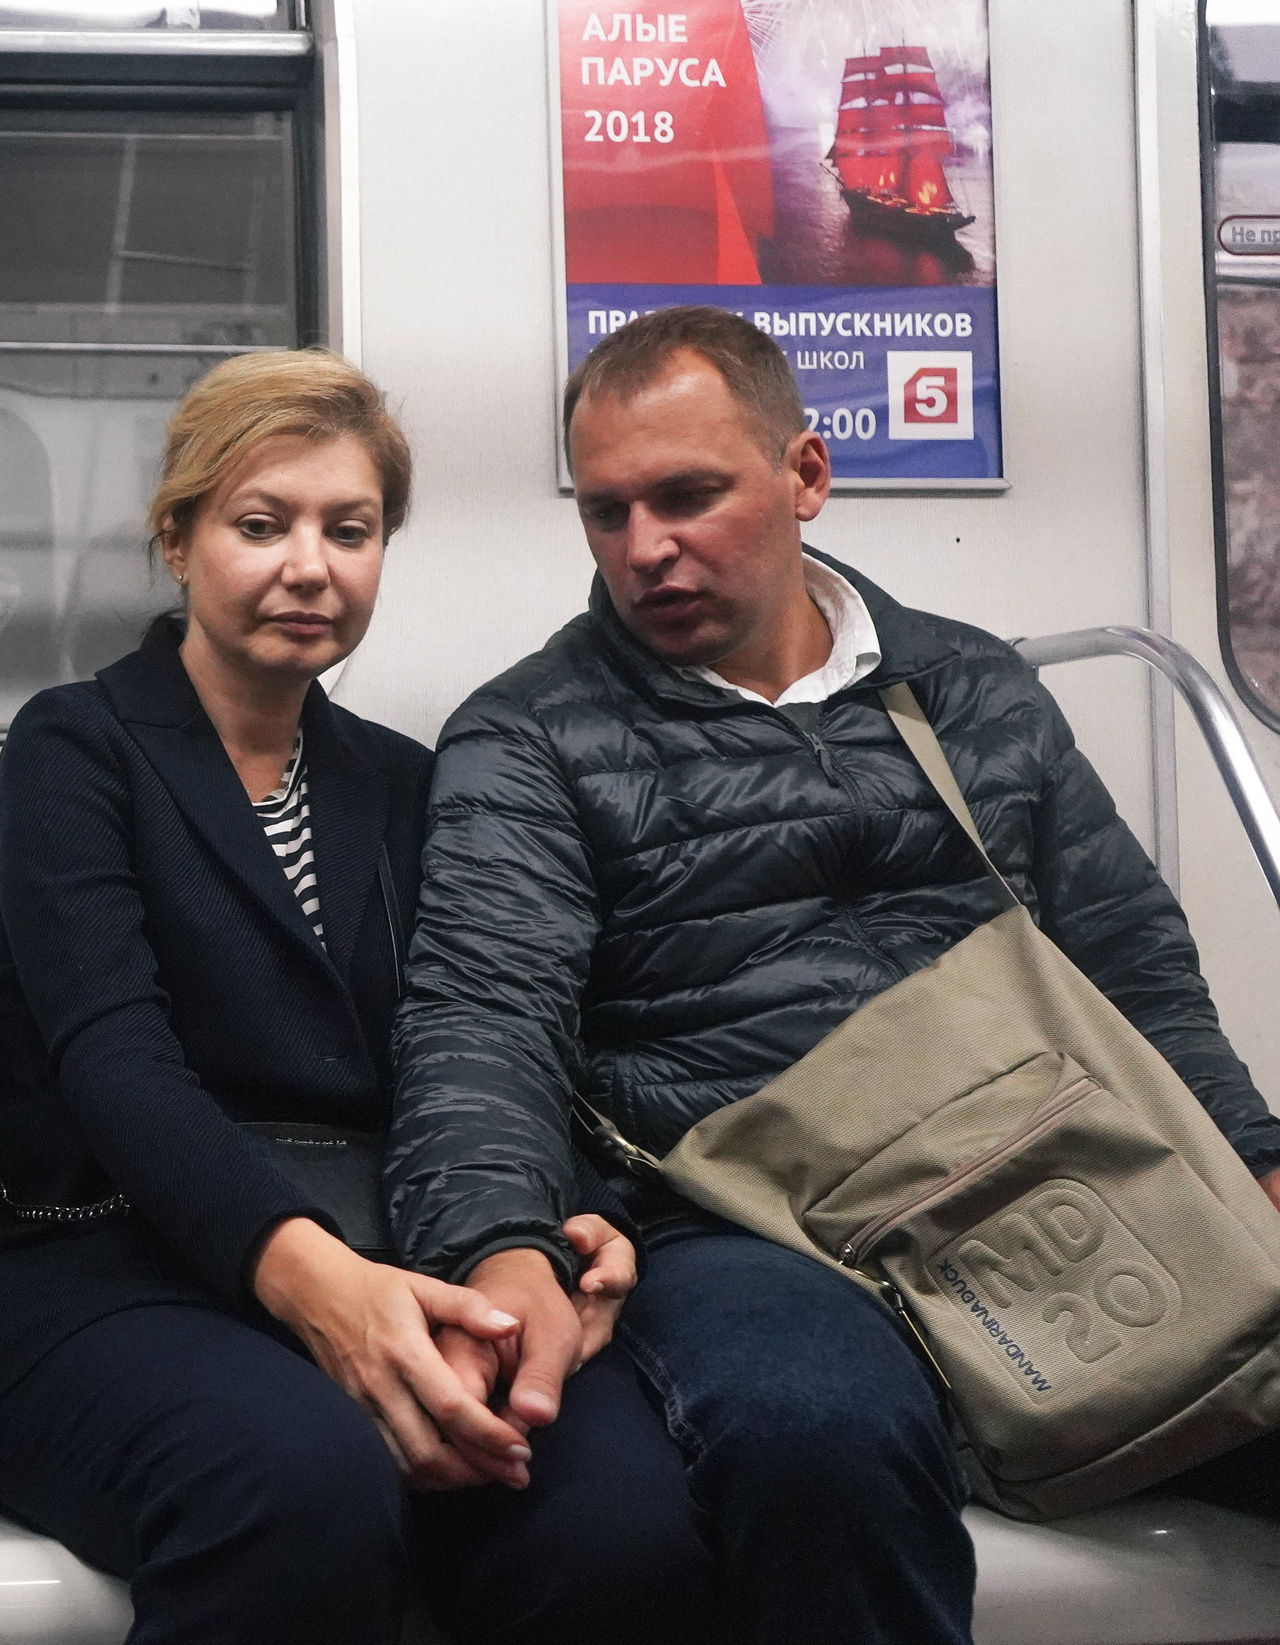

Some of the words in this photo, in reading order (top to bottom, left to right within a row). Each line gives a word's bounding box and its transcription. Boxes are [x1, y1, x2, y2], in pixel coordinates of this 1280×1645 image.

[581, 12, 688, 43] АЛЫЕ
[581, 56, 727, 88] ПАРУСА
[584, 109, 675, 144] 2018
[1231, 226, 1256, 243] Не
[753, 311, 973, 337] ВЫПУСКНИКОВ
[796, 350, 865, 370] ШКОЛ
[914, 375, 949, 418] 5
[957, 1188, 1107, 1310] MD
